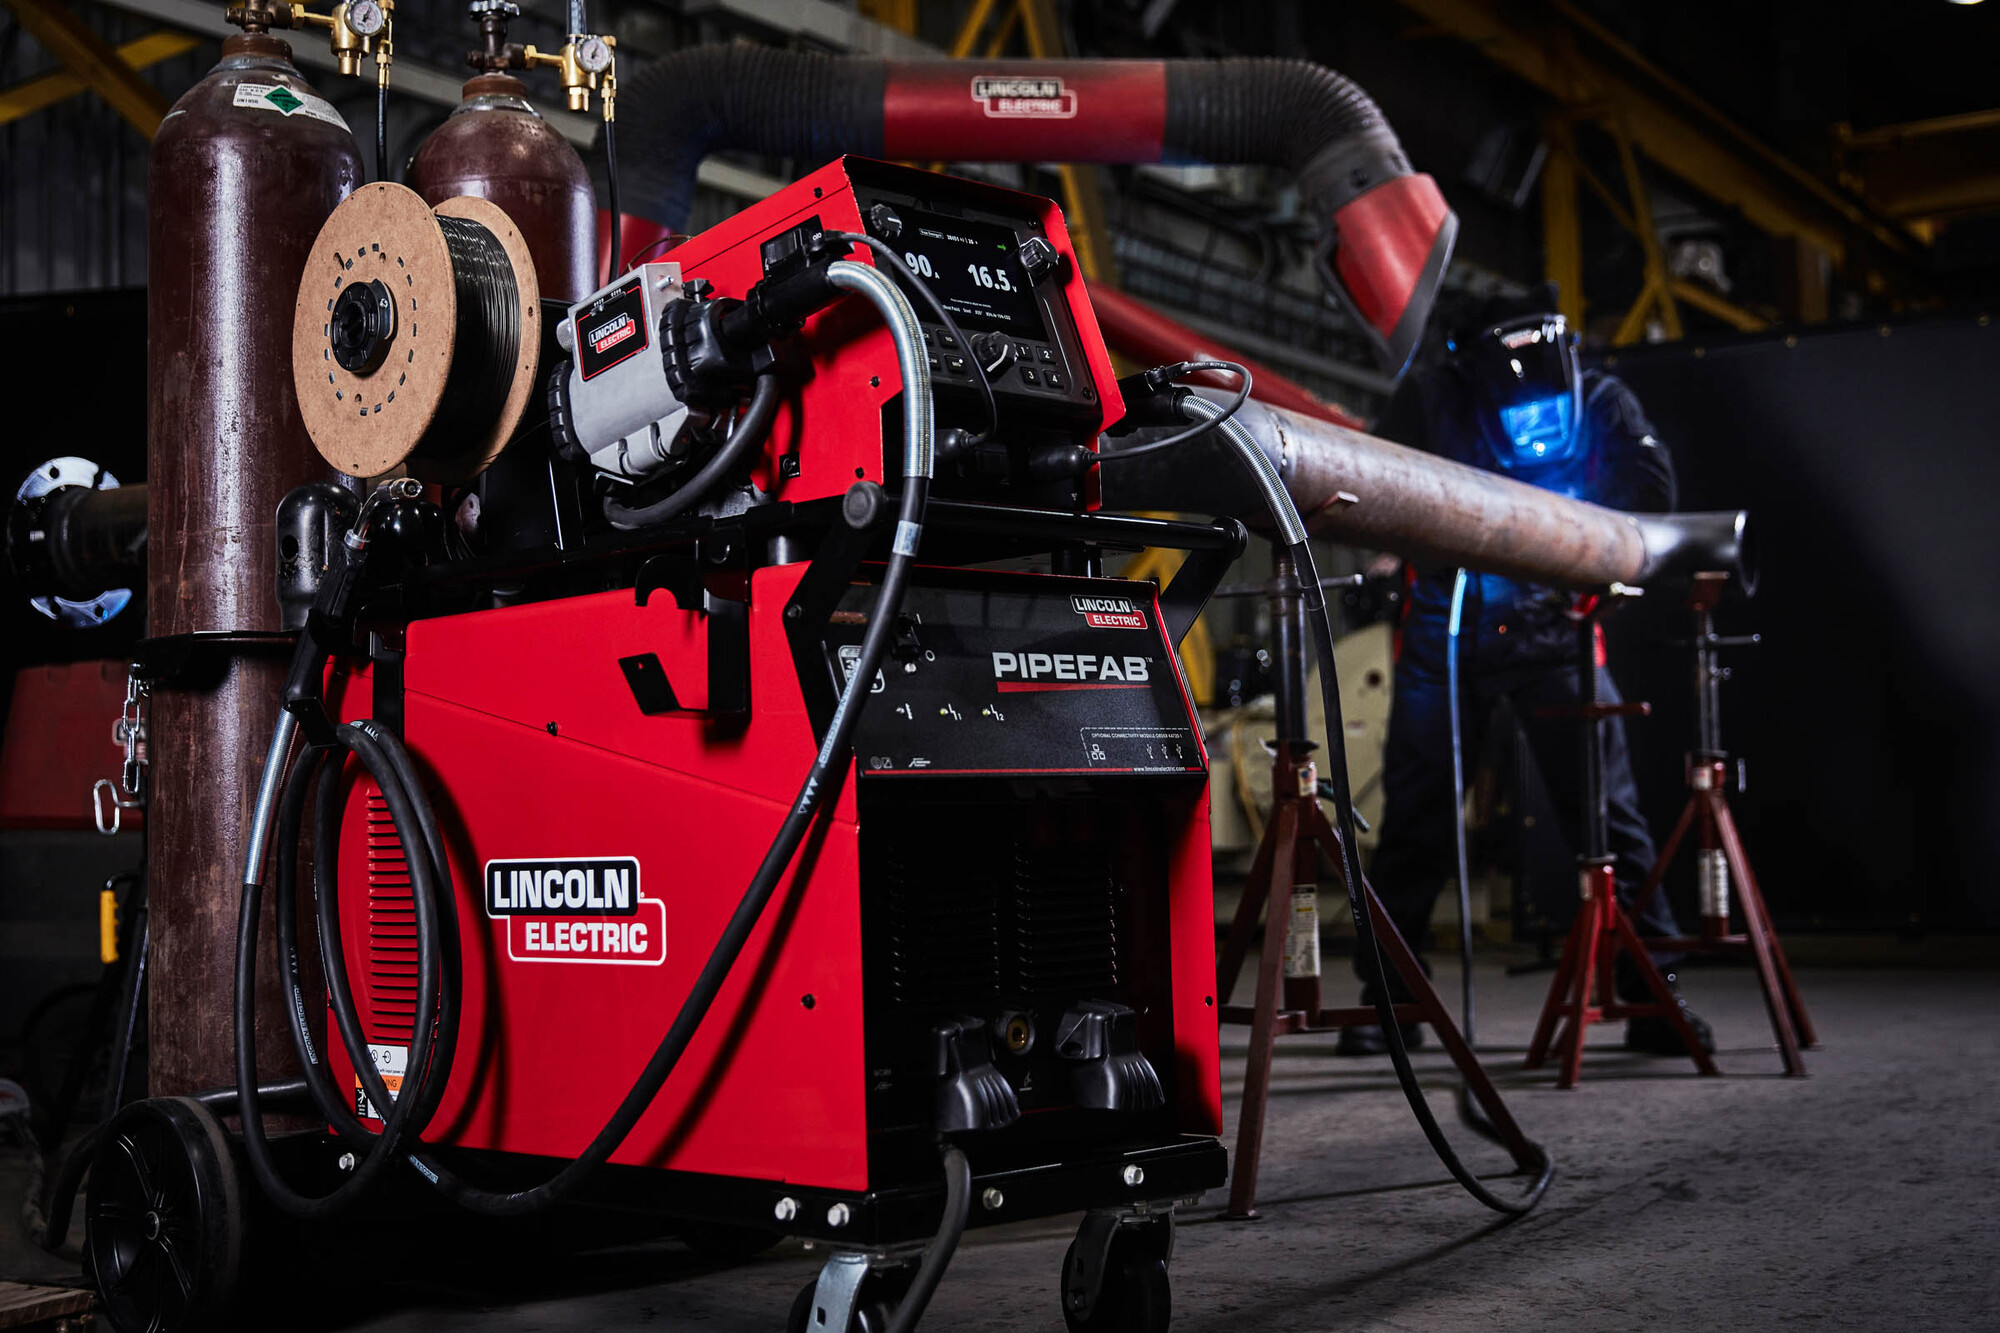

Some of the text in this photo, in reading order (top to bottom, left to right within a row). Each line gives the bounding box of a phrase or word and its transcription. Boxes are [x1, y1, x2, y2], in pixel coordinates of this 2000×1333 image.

[978, 81, 1058, 97] LINCOLN
[967, 263, 1011, 292] 16.5
[590, 316, 627, 344] LINCOLN
[600, 326, 633, 349] ELECTRIC
[1043, 350, 1050, 359] 2
[1027, 371, 1034, 380] 3
[1052, 375, 1059, 383] 4
[1075, 597, 1132, 613] LINCOLN
[1092, 613, 1142, 627] ELECTRIC
[494, 868, 630, 909] LINCOLN
[525, 922, 649, 954] ELECTRIC
[294, 988, 319, 1065] LINCOLN ELECTRIC
